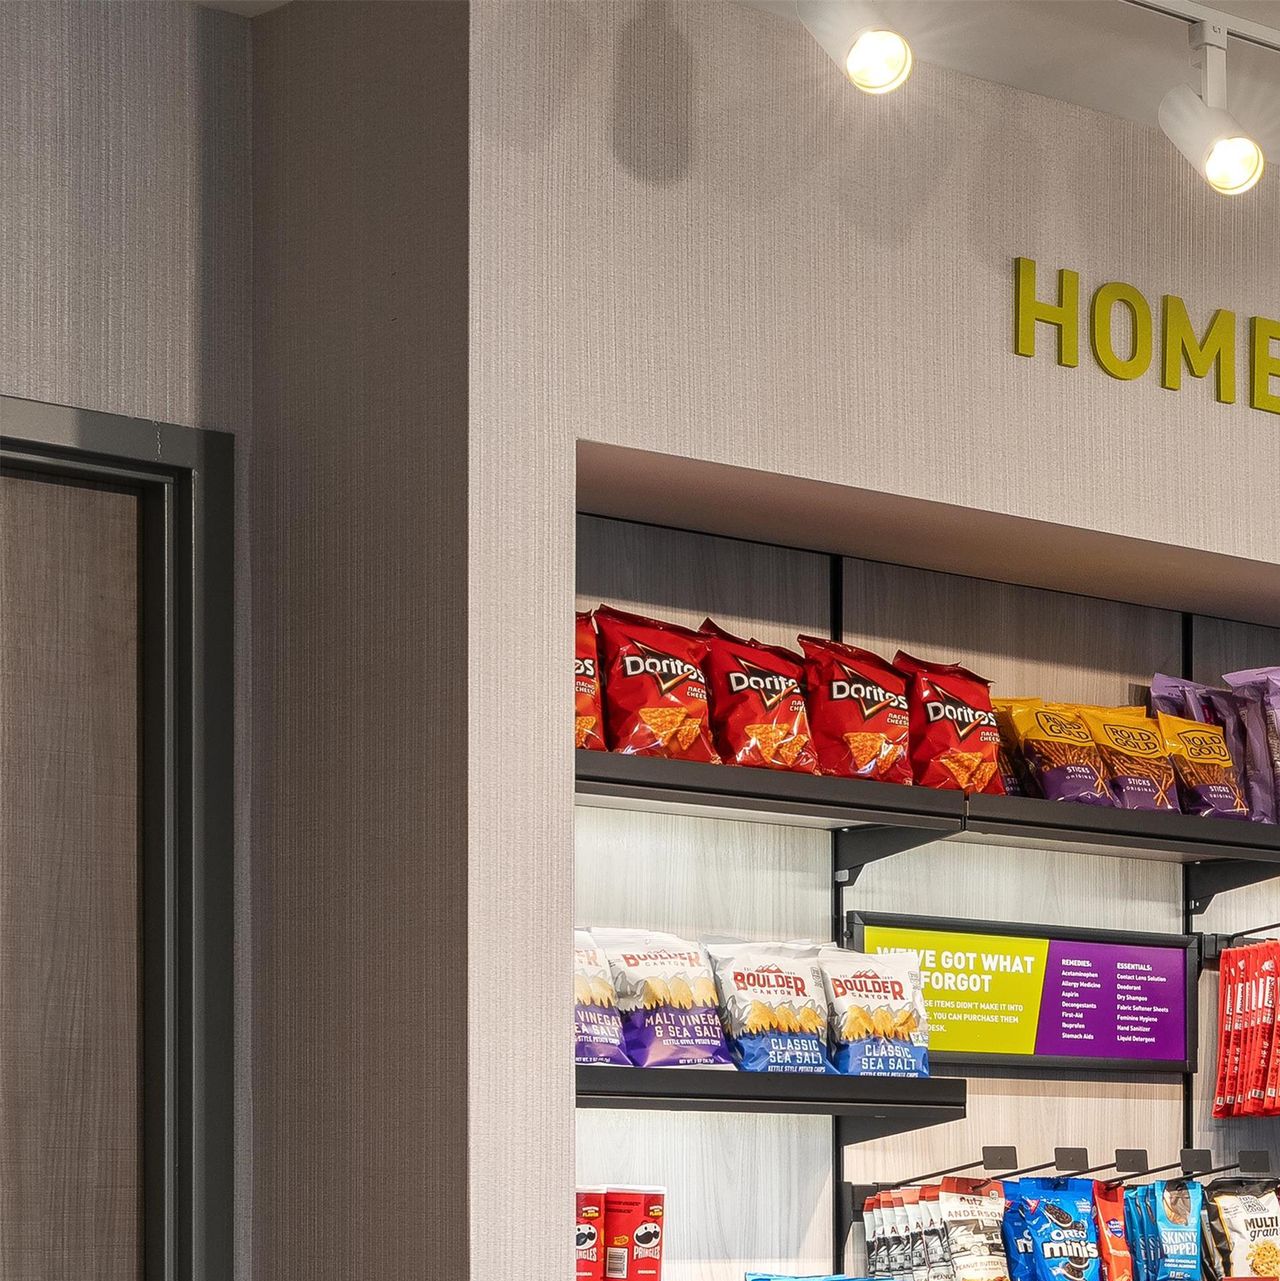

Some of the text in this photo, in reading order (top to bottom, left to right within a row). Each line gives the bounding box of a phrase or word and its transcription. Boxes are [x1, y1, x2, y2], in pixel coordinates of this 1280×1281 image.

[832, 681, 908, 710] Doritos
[1109, 726, 1152, 743] ROLD
[1114, 736, 1158, 752] GOLD
[941, 951, 977, 970] GOT
[981, 953, 1035, 974] WHAT
[1061, 959, 1093, 968] REMEDIES:
[1116, 962, 1153, 971] ESSENTIALS:
[1061, 970, 1099, 978] Acetaminophen
[1116, 973, 1135, 981] Contact
[1147, 975, 1167, 983] Solution
[733, 971, 808, 998] BOULDER
[921, 971, 992, 992] FORGOT
[1061, 980, 1101, 989] Allergy Medicine
[1116, 983, 1142, 991] Deodorant
[831, 977, 906, 1000] BOULDER
[1116, 994, 1148, 1003] Dry Shampoo
[934, 1000, 956, 1009] ITEMS
[956, 1001, 978, 1010] DIDN'T
[979, 1002, 999, 1011] MAKE
[1000, 1003, 1007, 1011] IT
[1007, 1003, 1024, 1012] INTO
[1061, 1001, 1098, 1009] Decongestants
[933, 1012, 1019, 1024] YOU CAN PURCHASE THEM
[1061, 1011, 1084, 1019] First-Aid
[1116, 1014, 1158, 1023] Feminine Hygiene
[1061, 1022, 1086, 1030] Ibuprofen
[1130, 1025, 1151, 1033] Sanitizer
[1061, 1032, 1083, 1040] Stomach
[1116, 1035, 1156, 1044] Liquid Detergent
[771, 1038, 819, 1051] CLASSIC
[861, 1057, 916, 1071] SEA SALT
[1244, 1218, 1279, 1231] MULTI
[1050, 1229, 1088, 1242] OREO
[1161, 1230, 1199, 1245] SKINNY
[1249, 1227, 1280, 1243] grain
[1043, 1242, 1099, 1260] minis
[1162, 1242, 1198, 1257] DIPPED
